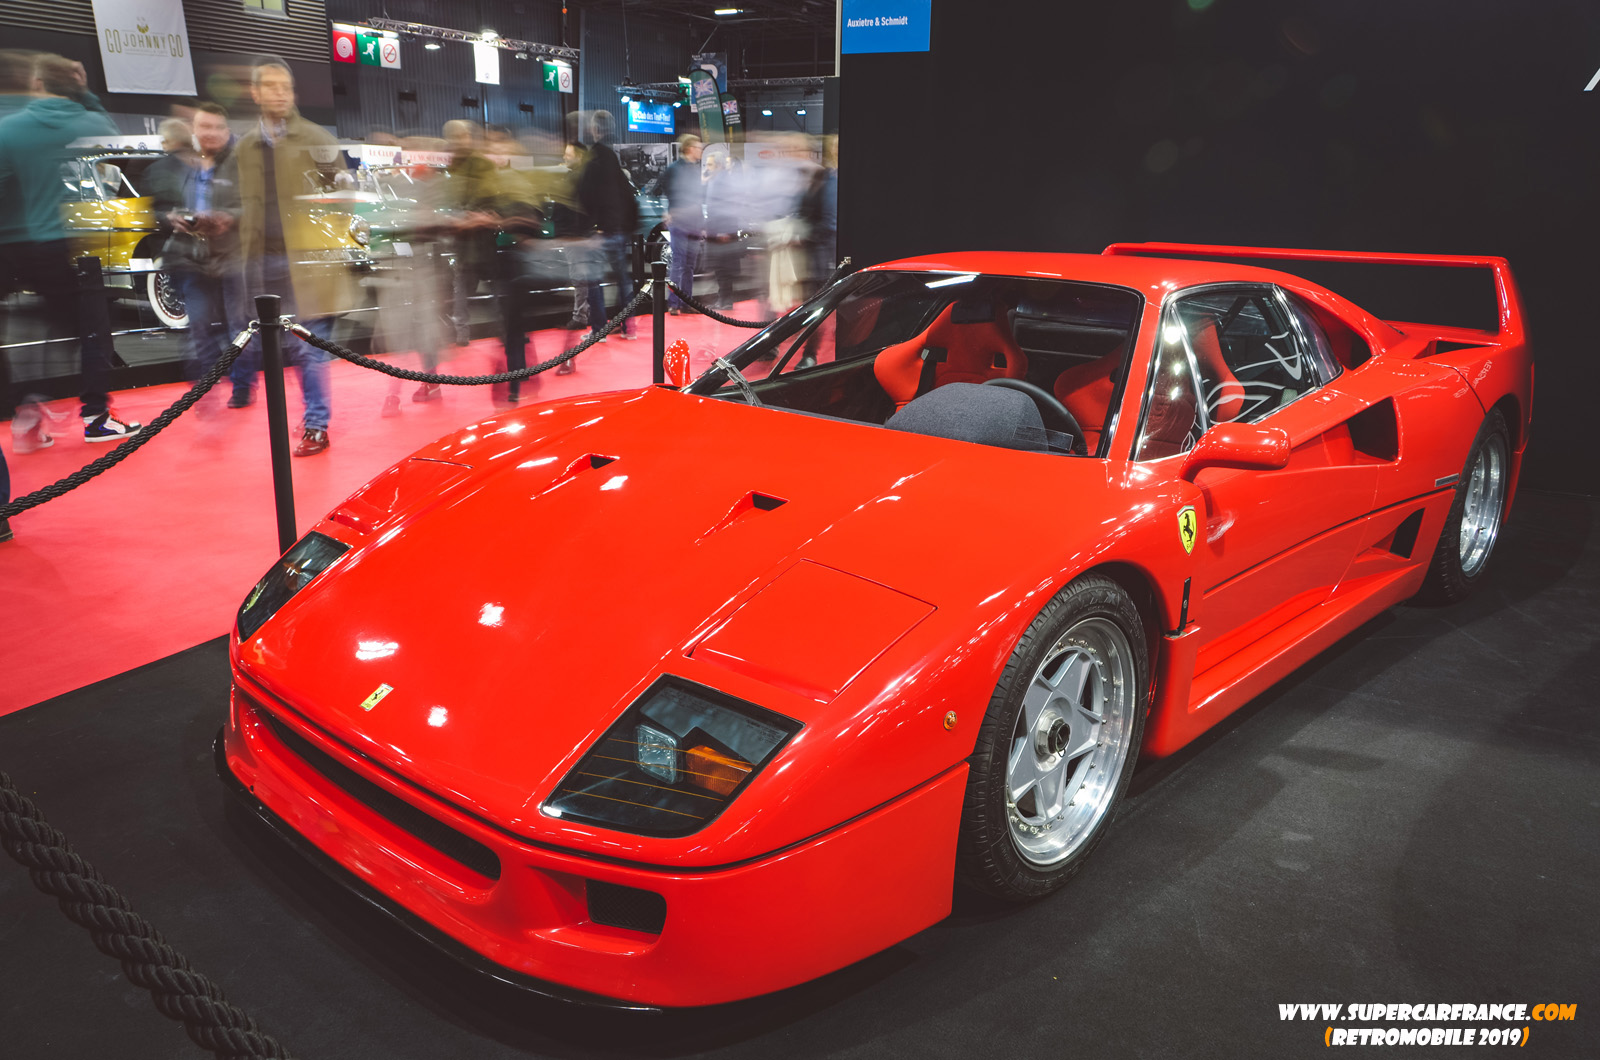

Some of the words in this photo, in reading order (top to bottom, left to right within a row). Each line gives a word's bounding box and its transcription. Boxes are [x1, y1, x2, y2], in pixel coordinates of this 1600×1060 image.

[847, 18, 874, 28] Auxietre
[875, 17, 880, 27] &
[881, 16, 908, 26] Schmidt
[104, 28, 122, 54] GO
[123, 33, 166, 49] JOHNNY
[168, 33, 184, 58] GO
